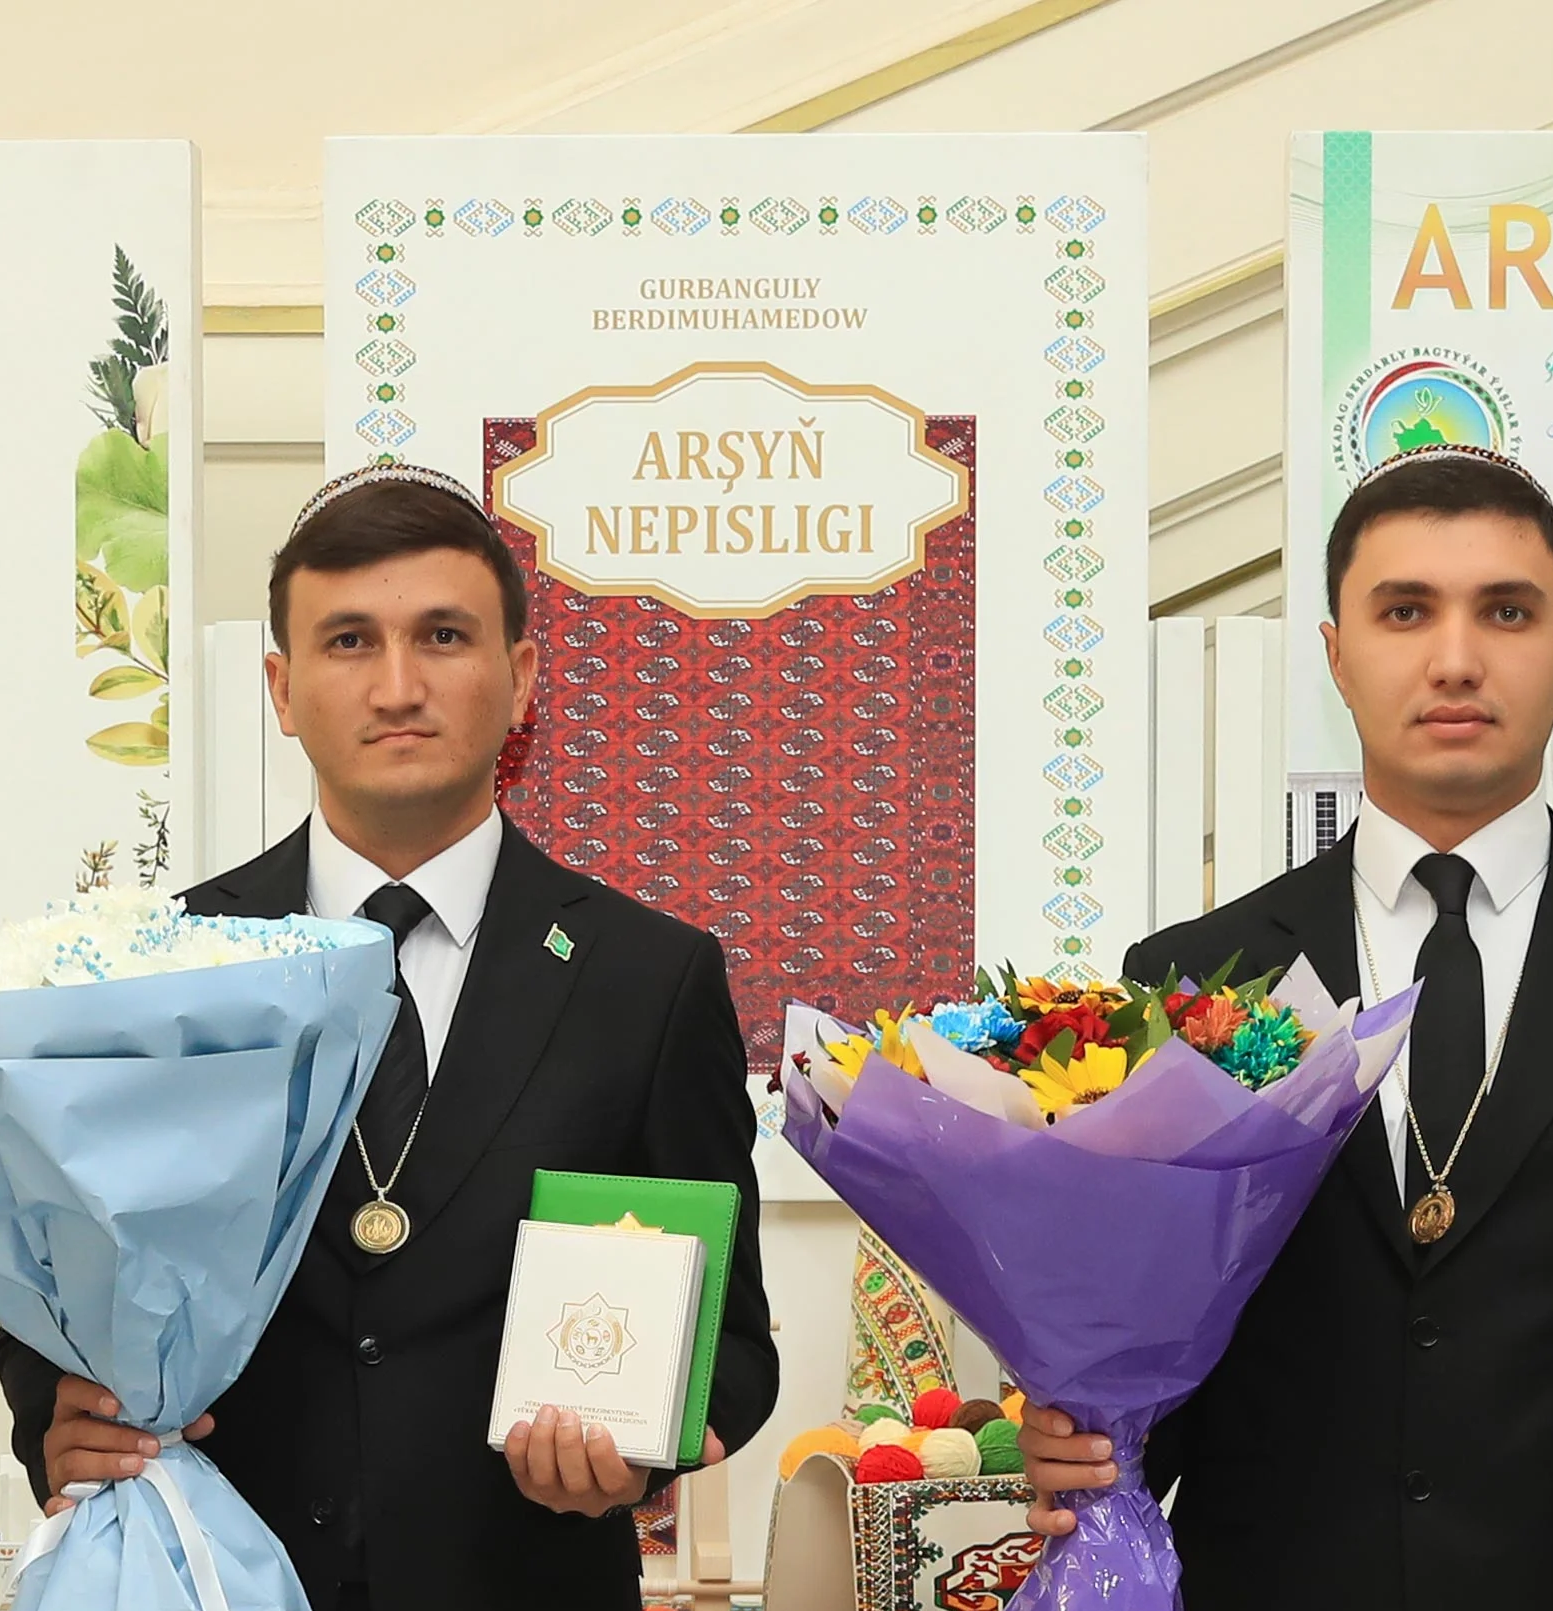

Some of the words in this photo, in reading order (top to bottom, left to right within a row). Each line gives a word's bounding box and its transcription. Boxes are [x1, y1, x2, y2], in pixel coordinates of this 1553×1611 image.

[639, 277, 822, 301] GURBANGULY
[592, 307, 868, 331] BERDIMUHAMEDOW
[1333, 403, 1349, 472] ARKADAG
[1346, 349, 1407, 401] SERDARLY
[631, 415, 826, 495] ARŞYŇ
[585, 503, 875, 555] NEPISLIGI
